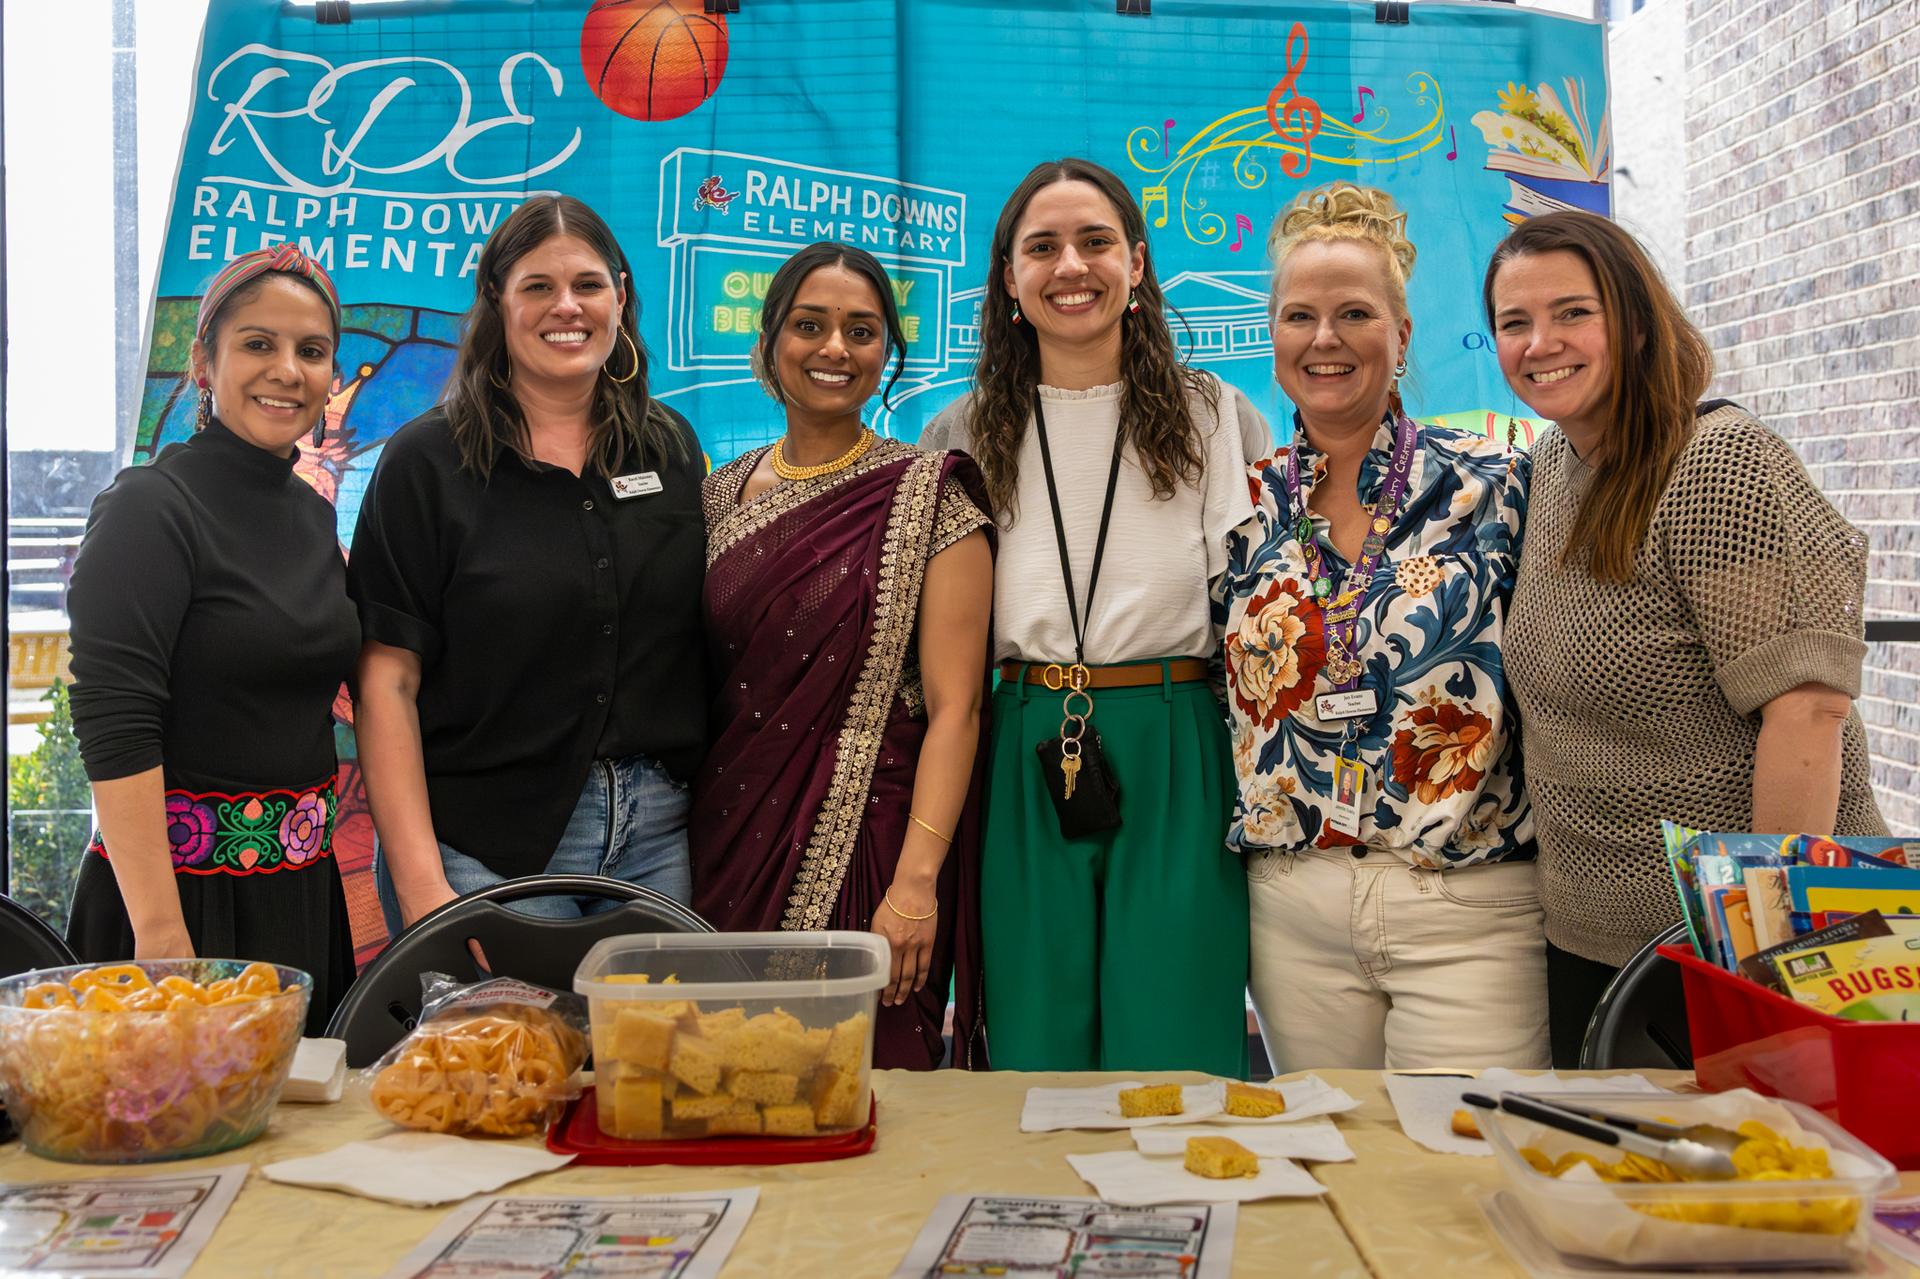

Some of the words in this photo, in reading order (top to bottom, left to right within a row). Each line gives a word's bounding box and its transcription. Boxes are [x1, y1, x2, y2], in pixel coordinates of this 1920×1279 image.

[207, 43, 581, 196] RDE
[193, 185, 357, 228] RALPH
[383, 200, 520, 235] DOW
[745, 169, 851, 216] RALPH
[861, 189, 958, 233] DOWNS
[188, 224, 486, 278] ELEMENTA
[743, 211, 951, 253] ELEMENTARY
[724, 271, 775, 299] OU
